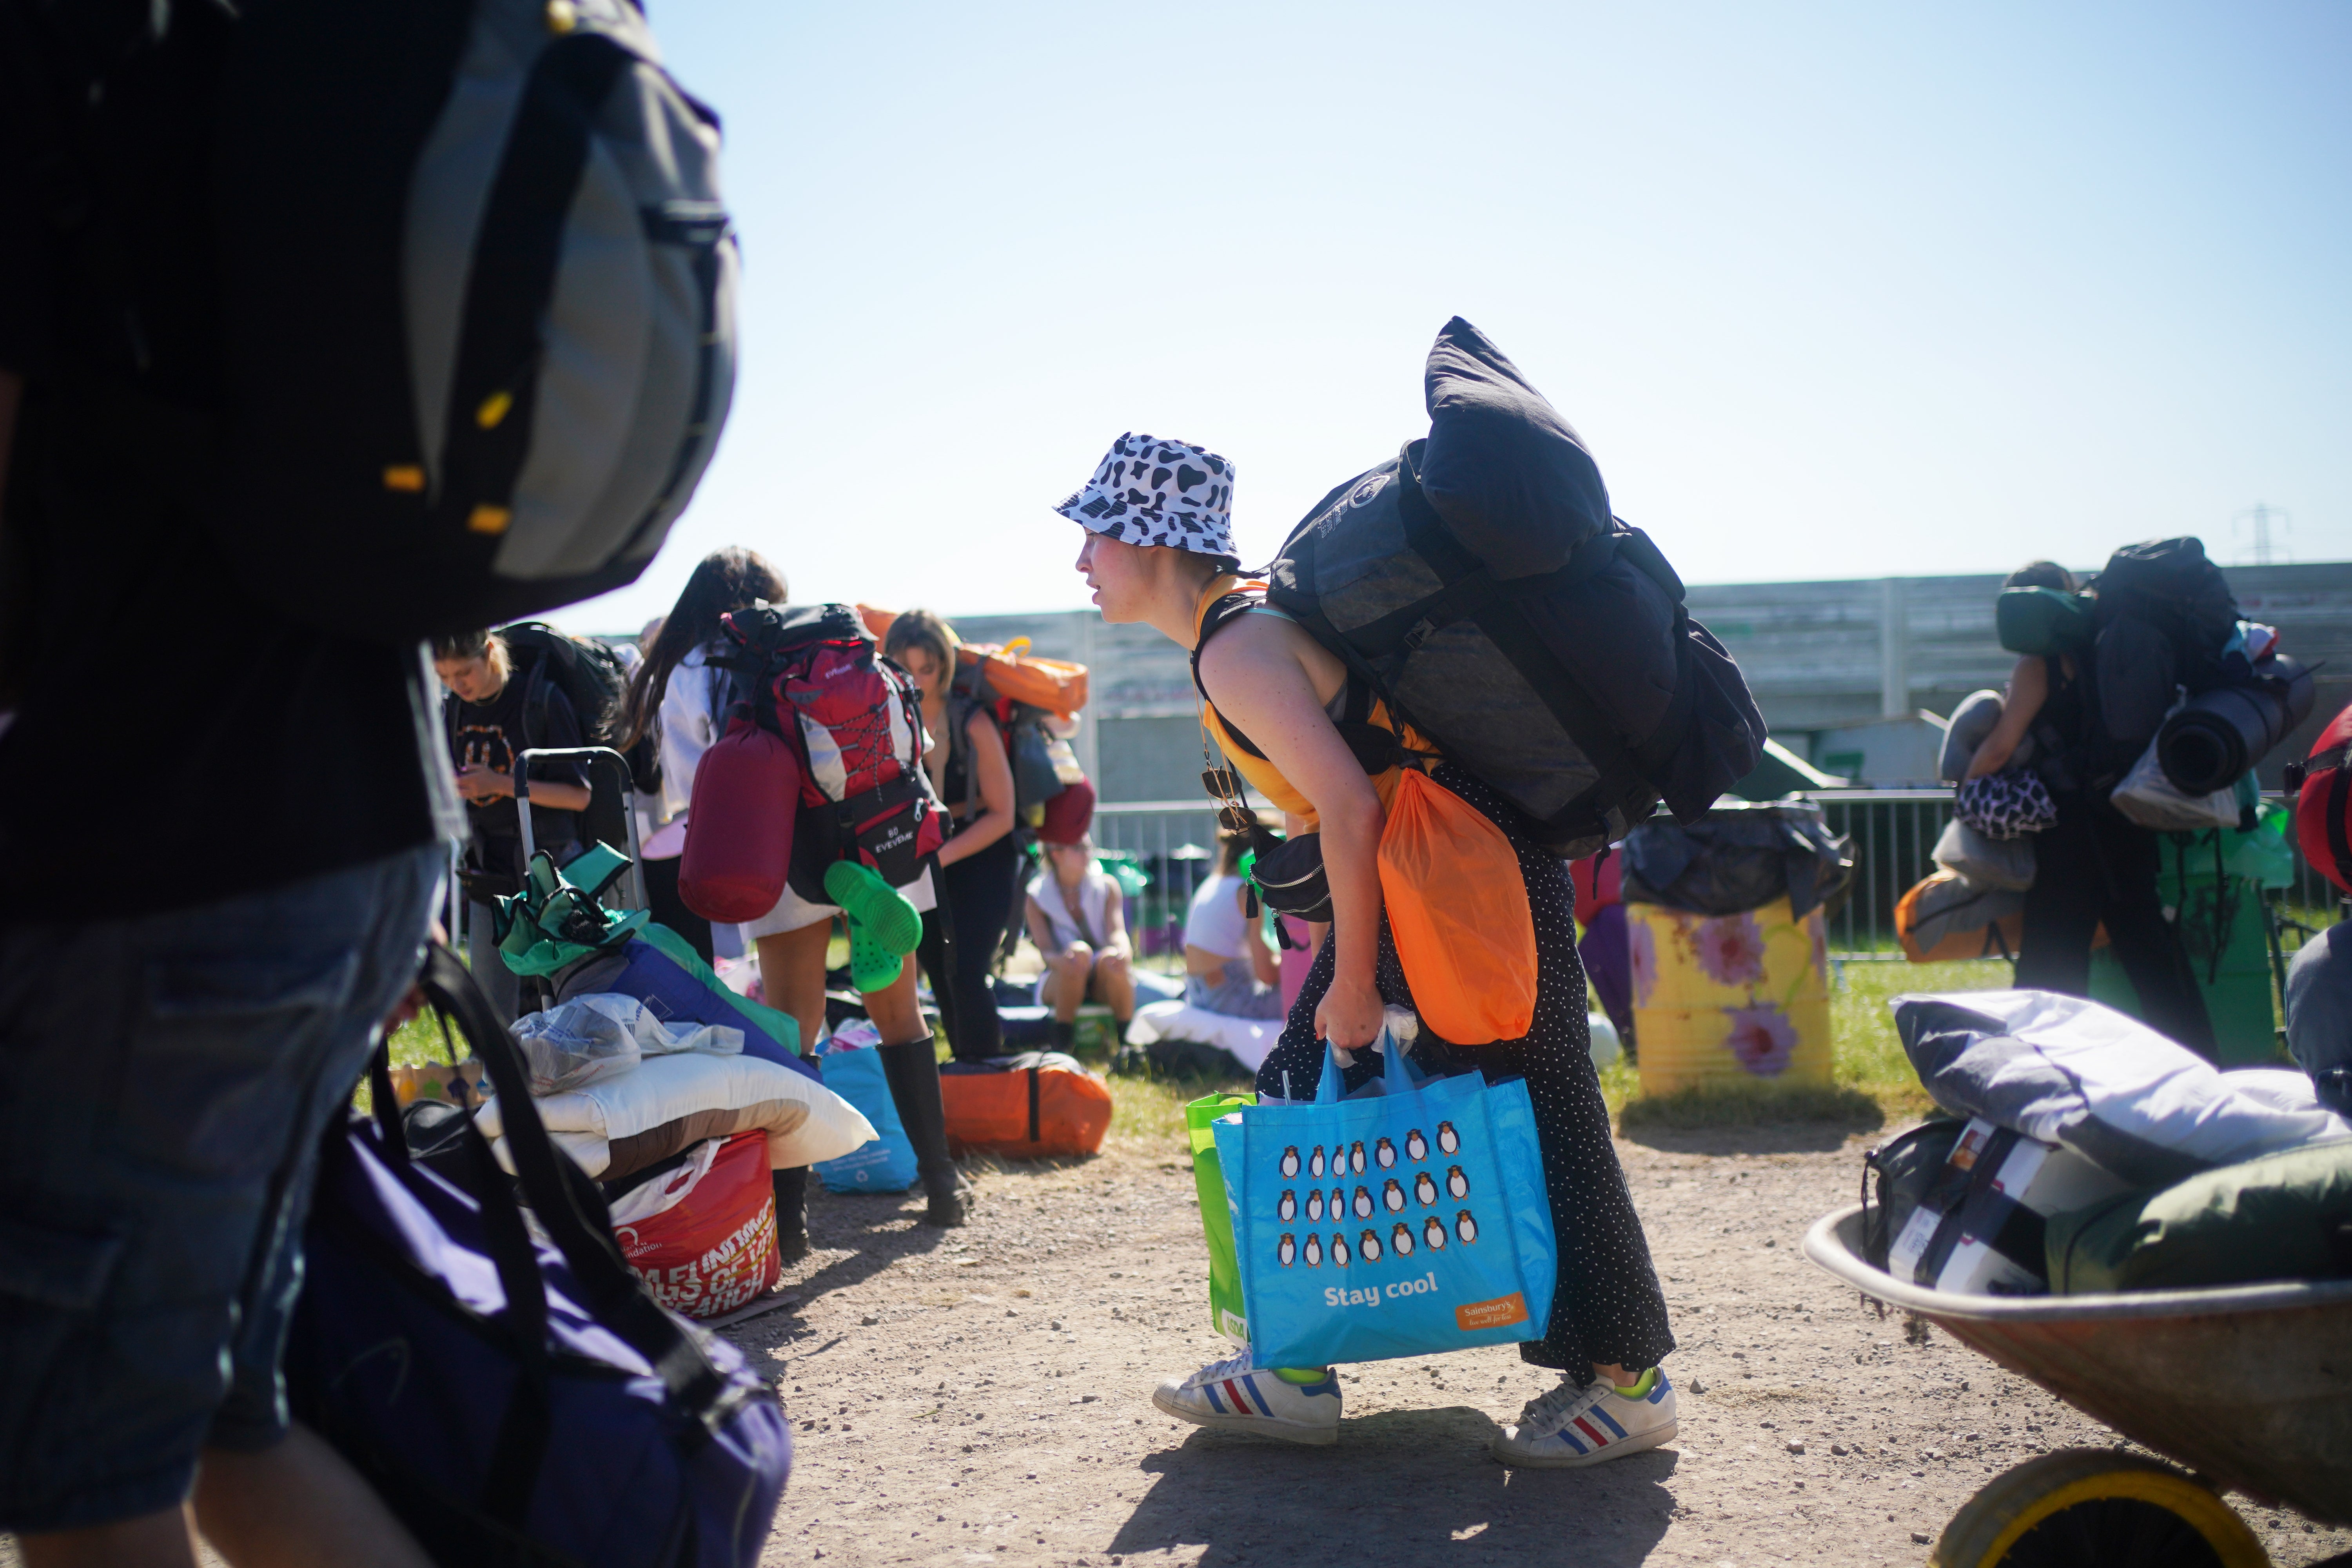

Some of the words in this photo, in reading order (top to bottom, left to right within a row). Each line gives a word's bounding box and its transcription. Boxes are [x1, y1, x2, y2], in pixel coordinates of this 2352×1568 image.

[888, 826, 898, 838] 80
[1324, 1286, 1381, 1307] Stay
[1386, 1272, 1438, 1298] cool
[1465, 1300, 1511, 1316] Sainsbury's
[1480, 1316, 1492, 1324] well
[1492, 1316, 1501, 1324] for
[1227, 1316, 1246, 1341] ASDA
